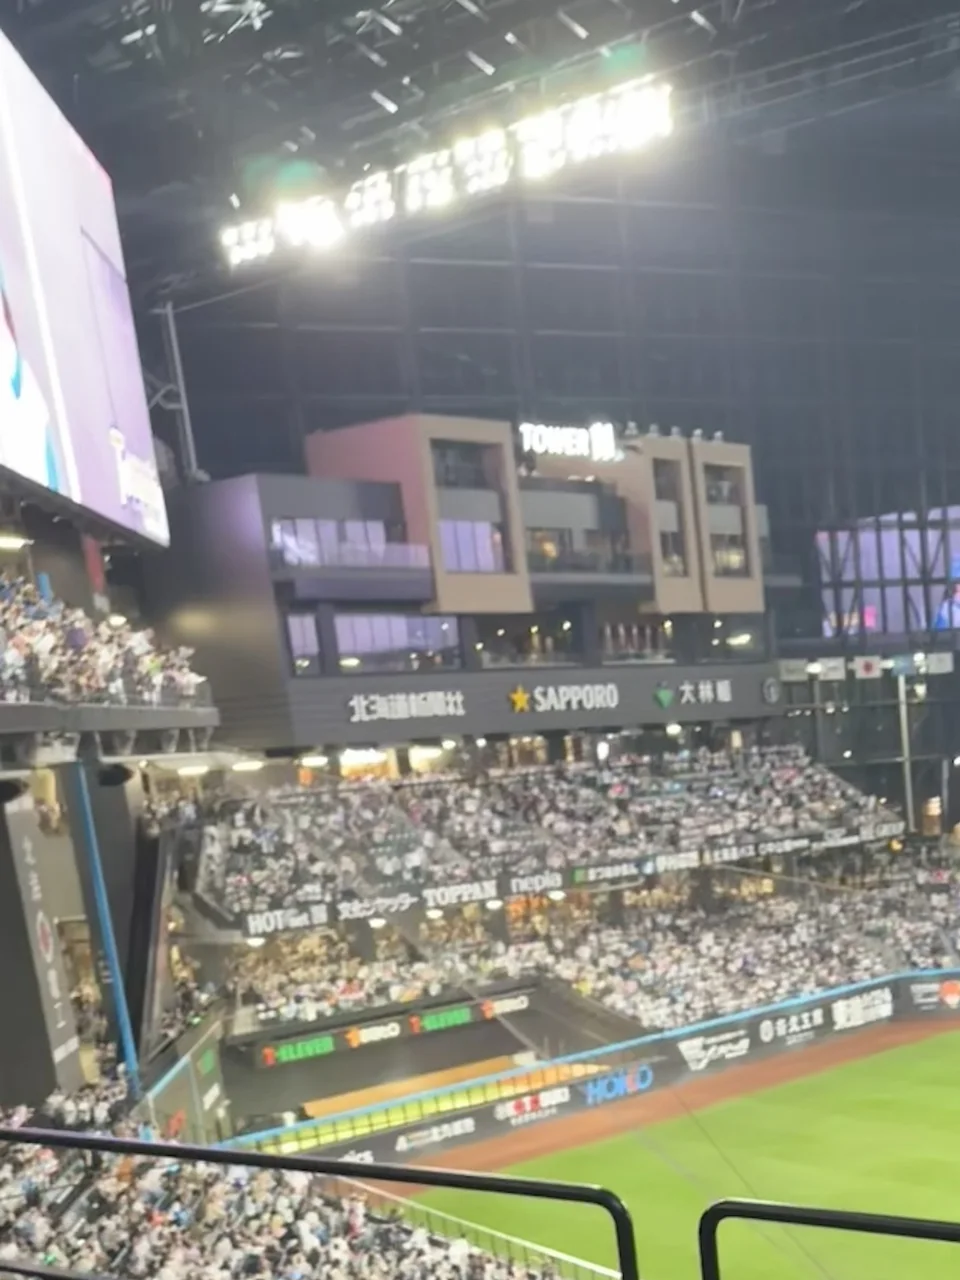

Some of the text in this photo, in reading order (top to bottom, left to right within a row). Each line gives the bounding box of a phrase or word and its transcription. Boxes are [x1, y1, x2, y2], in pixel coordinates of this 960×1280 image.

[534, 684, 619, 712] SAPPORO
[422, 879, 497, 907] TOPPAN
[511, 870, 563, 893] nepia
